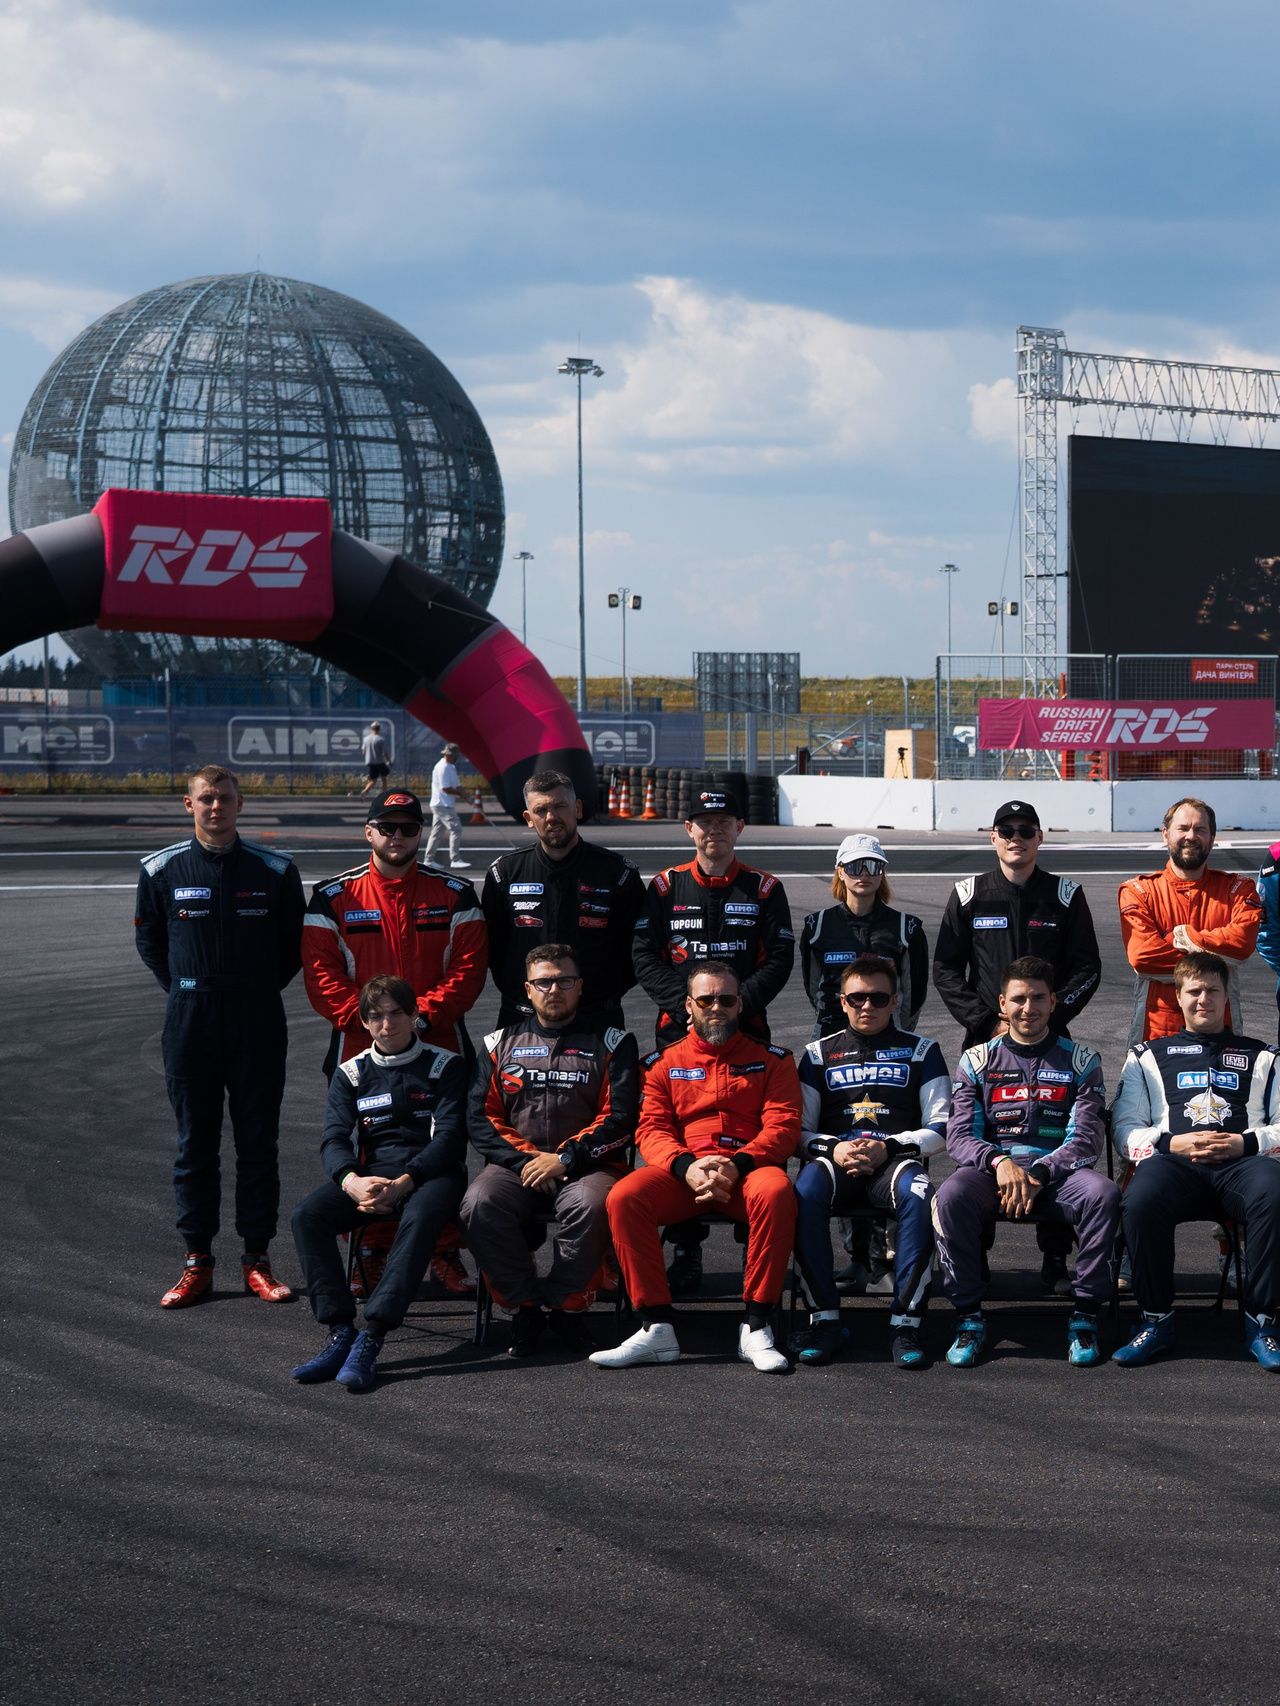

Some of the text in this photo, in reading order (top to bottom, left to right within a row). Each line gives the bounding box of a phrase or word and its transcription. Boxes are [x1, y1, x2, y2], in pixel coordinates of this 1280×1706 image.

[116, 524, 323, 588] RDS
[1195, 671, 1255, 681] ДАЧА ВИНТЕРА
[1038, 707, 1105, 719] RUSSIAN
[1053, 720, 1099, 731] DRIFT
[1105, 707, 1218, 744] RDS
[3, 725, 106, 754] MOL
[236, 727, 373, 756] AIMO
[1040, 732, 1093, 743] SERIES
[176, 888, 209, 899] AIMOL
[511, 885, 542, 893] AIMOL
[727, 905, 757, 913] AIMOL
[346, 912, 379, 921] AIMOL
[975, 919, 1005, 928] AIMOL
[826, 953, 855, 962] AIMOL
[513, 1048, 547, 1057] AIMOL
[878, 1049, 911, 1060] AIMOL
[1226, 1055, 1245, 1064] LEVEL
[527, 1069, 590, 1084] Tamashi
[671, 1068, 705, 1078] AIMOL
[830, 1063, 905, 1086] AIMOL
[1038, 1071, 1071, 1080] AIMOL
[1001, 1088, 1052, 1100] LAVR
[359, 1095, 390, 1110] AIMOL
